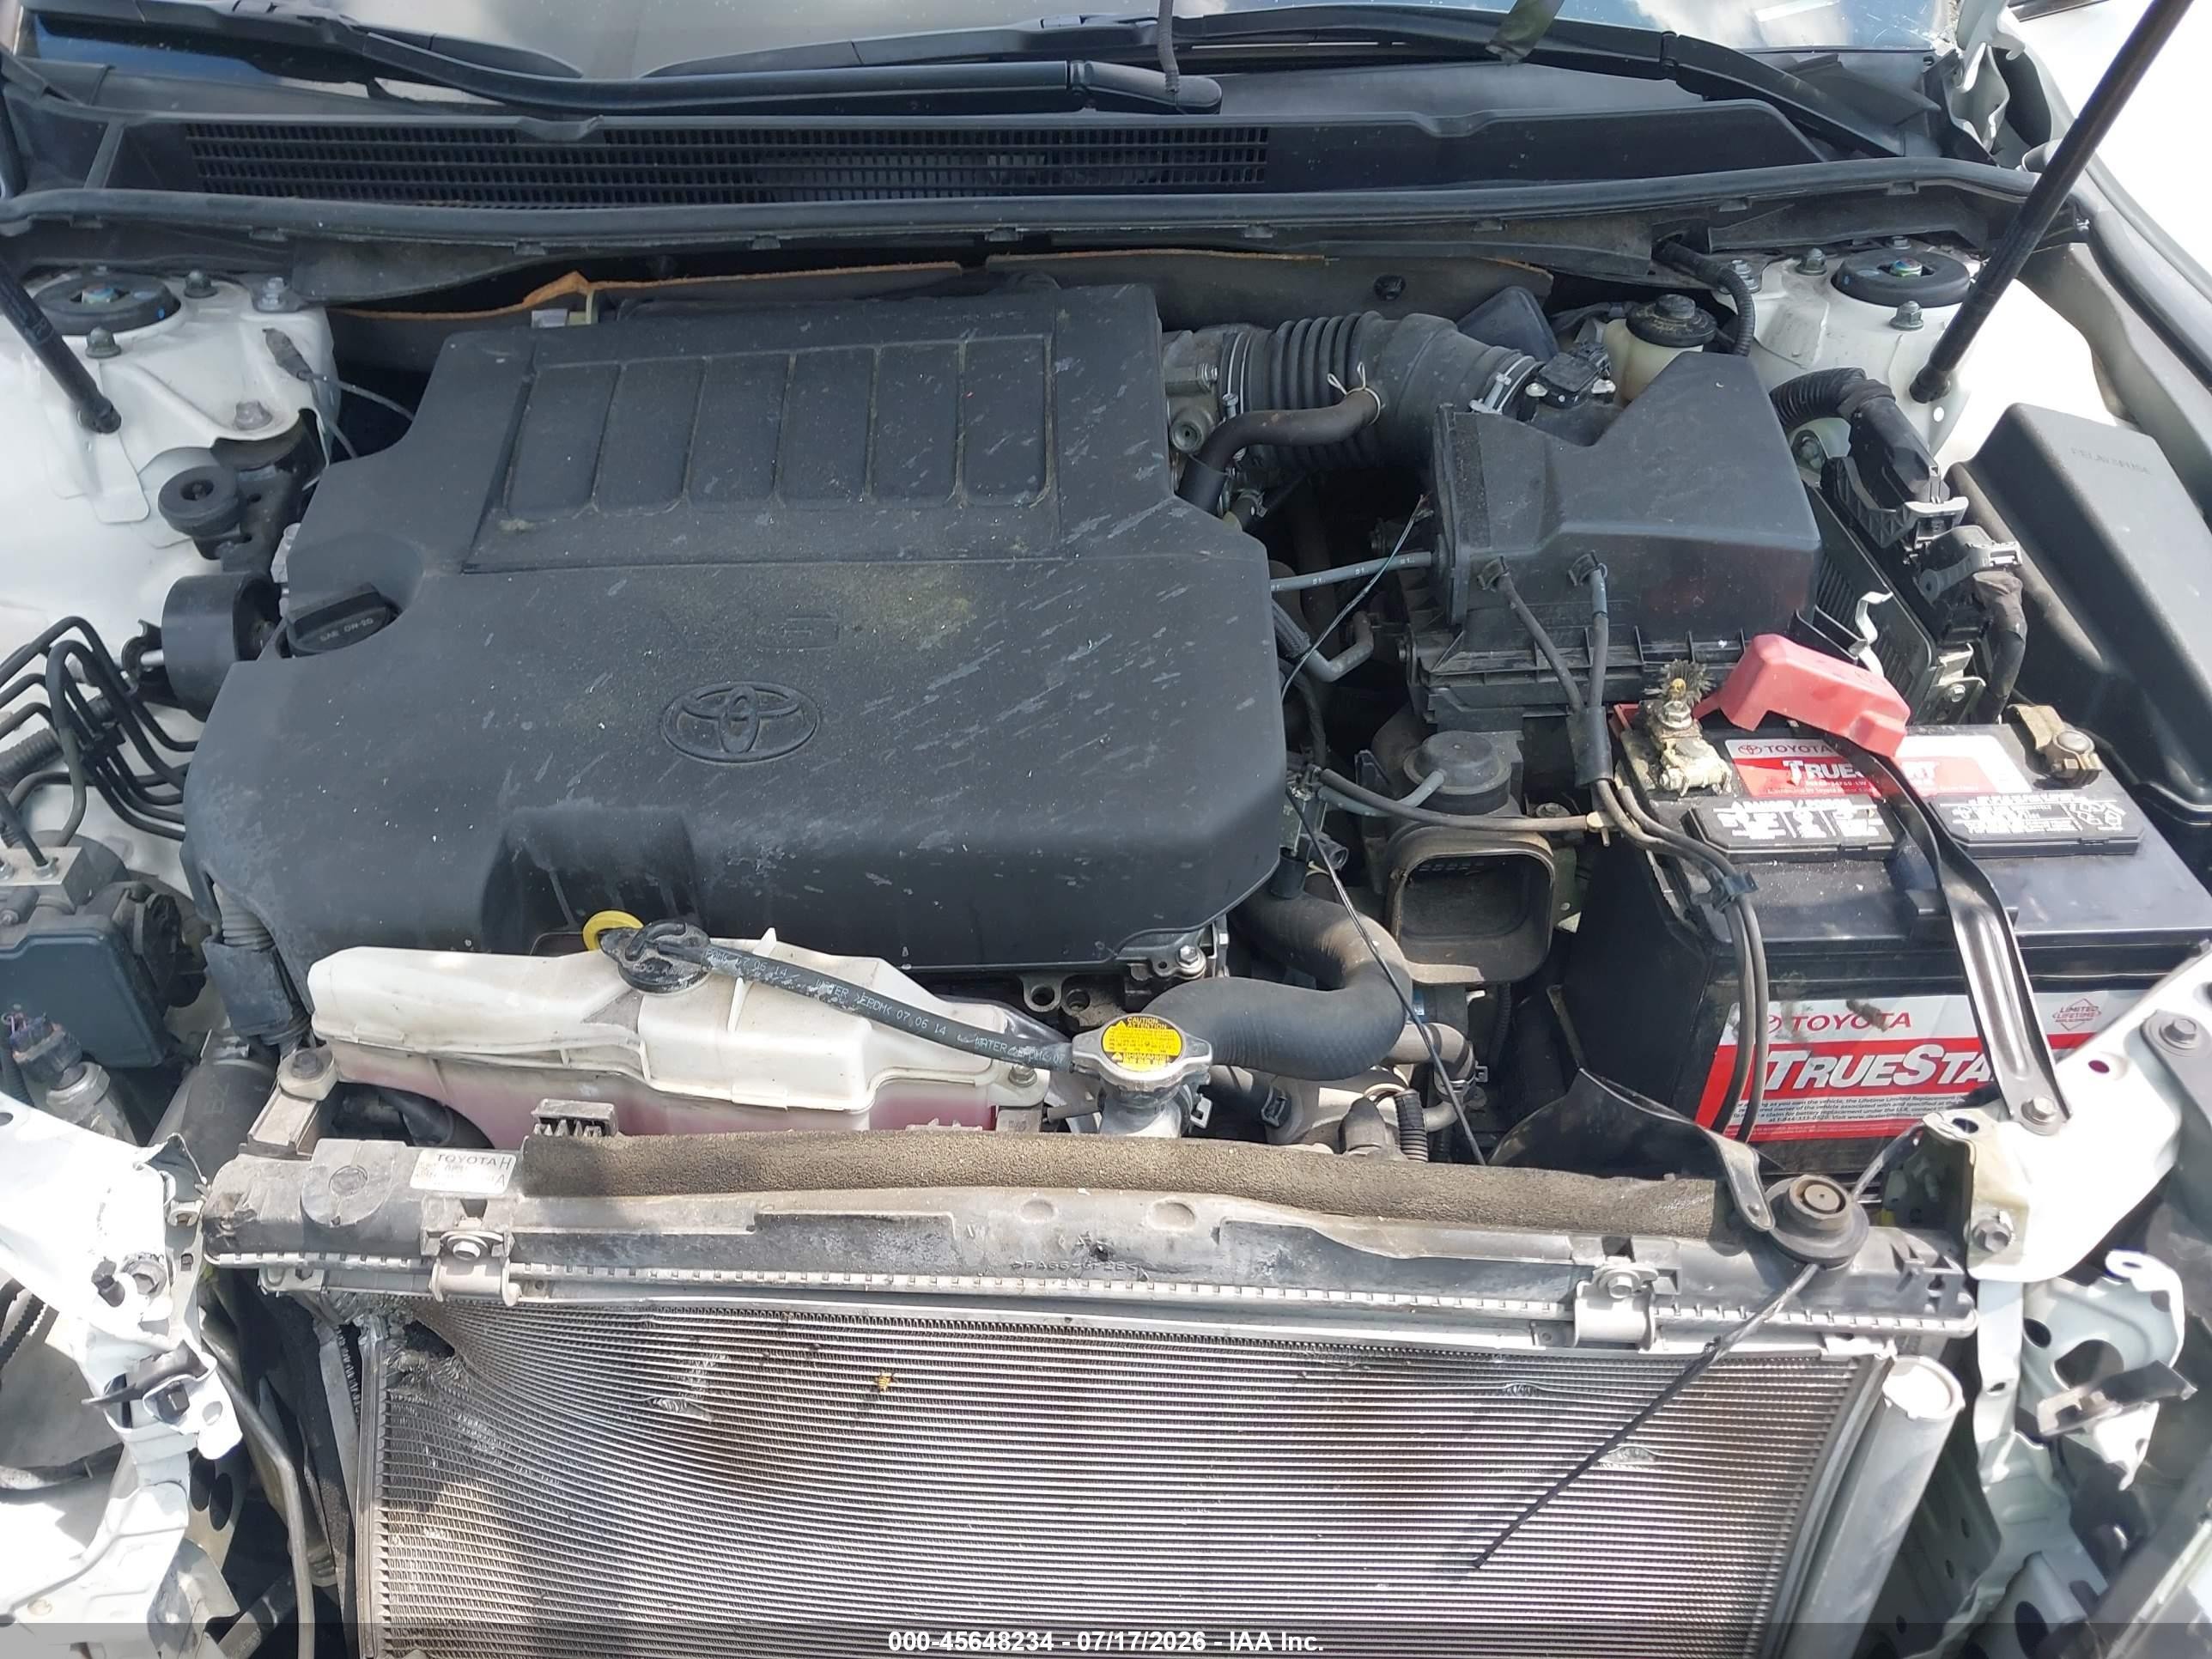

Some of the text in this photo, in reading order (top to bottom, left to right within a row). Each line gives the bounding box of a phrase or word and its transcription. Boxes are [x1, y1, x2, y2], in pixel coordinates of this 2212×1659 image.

[1763, 744, 1831, 753] TOYOTA
[1791, 1012, 1911, 1031] TOYOTA
[896, 1009, 910, 1022] 07
[915, 1017, 929, 1030] 06
[934, 1024, 946, 1036] 14
[975, 1036, 1008, 1054] WATER
[1765, 1044, 1994, 1091] TRUESTA
[437, 1154, 496, 1166] TOYOTA
